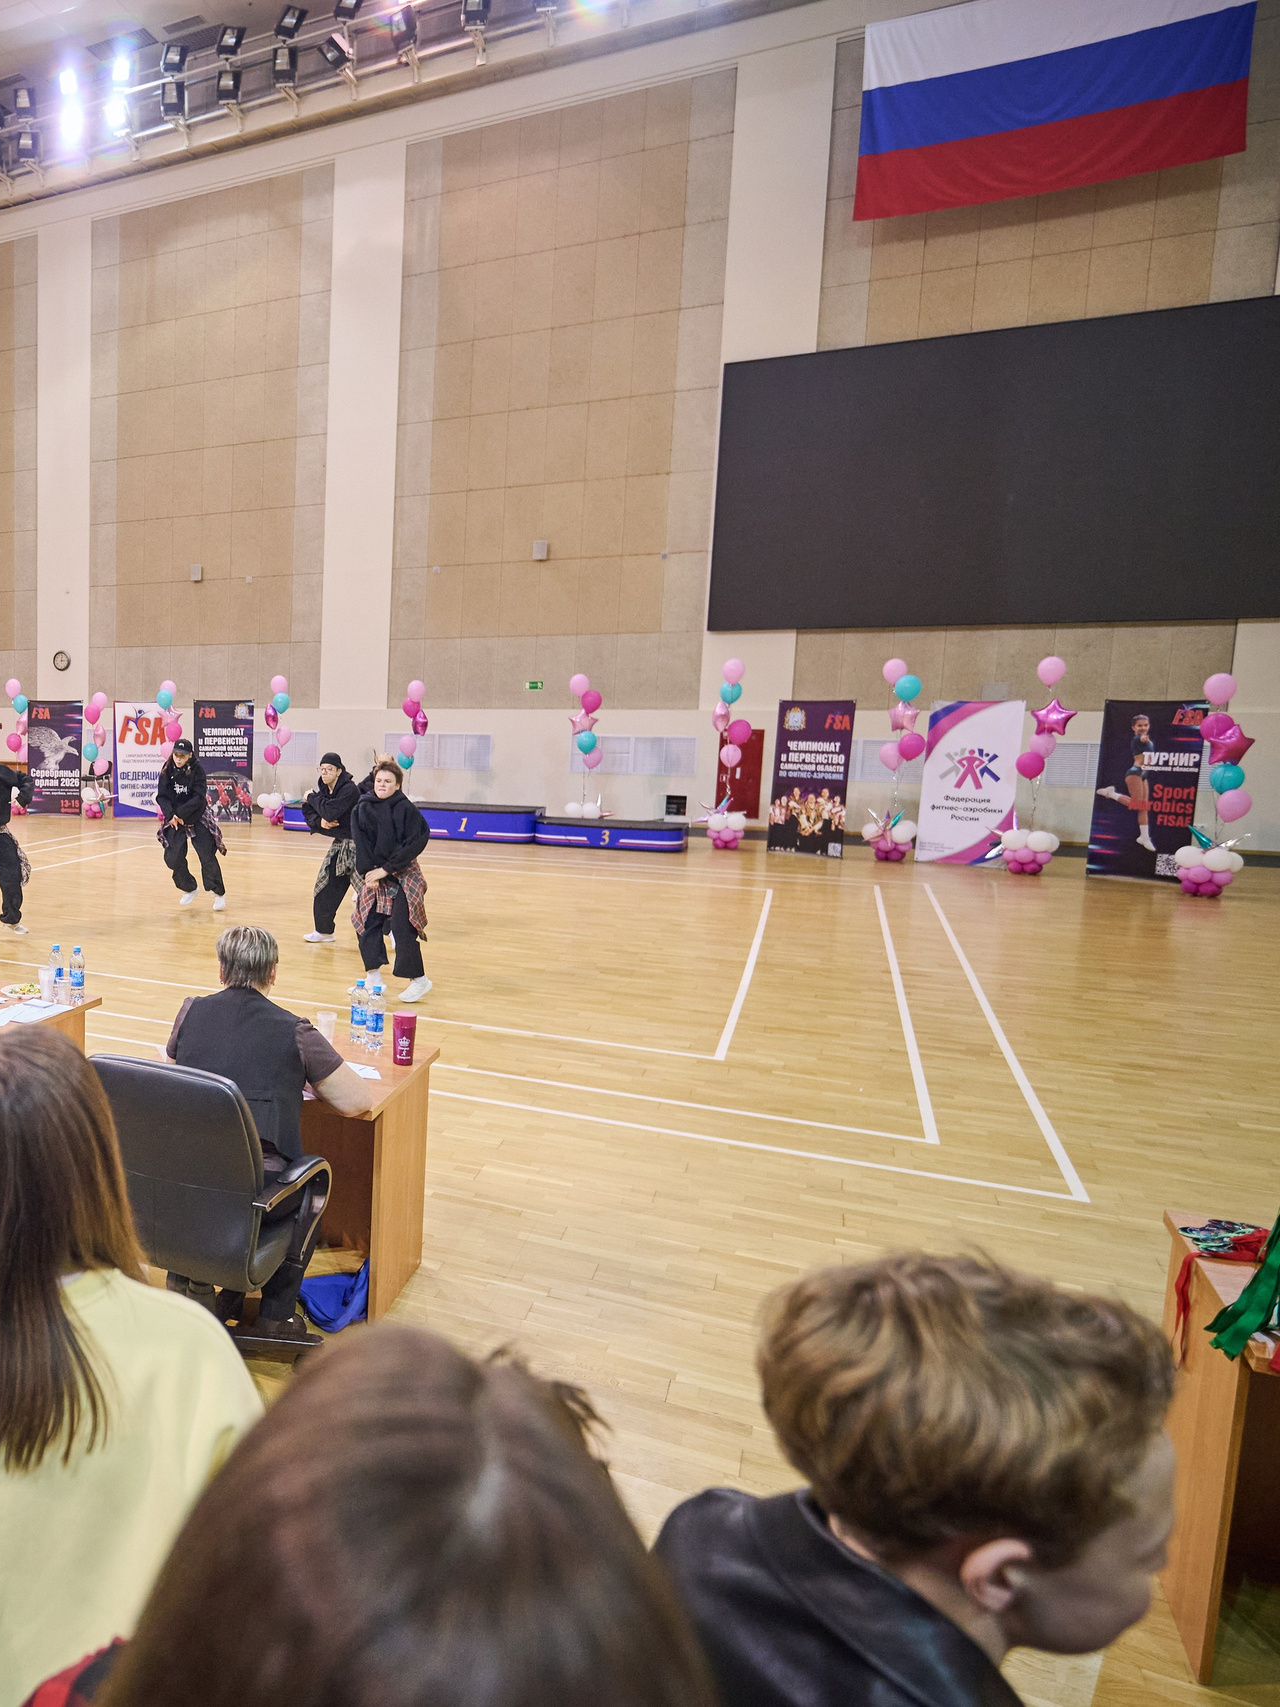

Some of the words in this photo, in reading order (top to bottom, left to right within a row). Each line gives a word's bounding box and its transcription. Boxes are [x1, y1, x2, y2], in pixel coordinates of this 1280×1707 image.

[31, 706, 50, 719] FSA
[198, 706, 216, 719] FSA
[1172, 708, 1204, 726] FSA
[824, 713, 851, 731] FSA
[118, 716, 167, 746] FSA
[202, 727, 245, 737] ЧЕМПИОНАТ
[204, 737, 249, 746] ПЕРВЕНСТВО
[787, 741, 841, 753] ЧЕМПИОНАТ
[788, 752, 845, 765] ПЕРВЕНСТВО
[1142, 751, 1200, 767] ТУРНИР
[30, 768, 80, 779] Серебряный
[780, 763, 816, 772] САМАРСКОЙ
[816, 764, 844, 773] ОБЛАСТИ
[120, 771, 160, 781] ФЕДЕРАЦИ
[779, 770, 787, 778] ПО
[787, 771, 844, 781] ФИТНЕС-АЭРОБИКЕ
[34, 778, 59, 788] орлан
[60, 778, 80, 787] 2026
[1152, 783, 1196, 801] Sport
[60, 799, 80, 808] 13-15
[943, 794, 991, 803] Федерация
[930, 803, 1003, 814] фитнес-аэробики
[950, 814, 980, 822] России
[1156, 814, 1192, 828] FISAF
[458, 817, 468, 832] 1
[600, 830, 610, 846] 3
